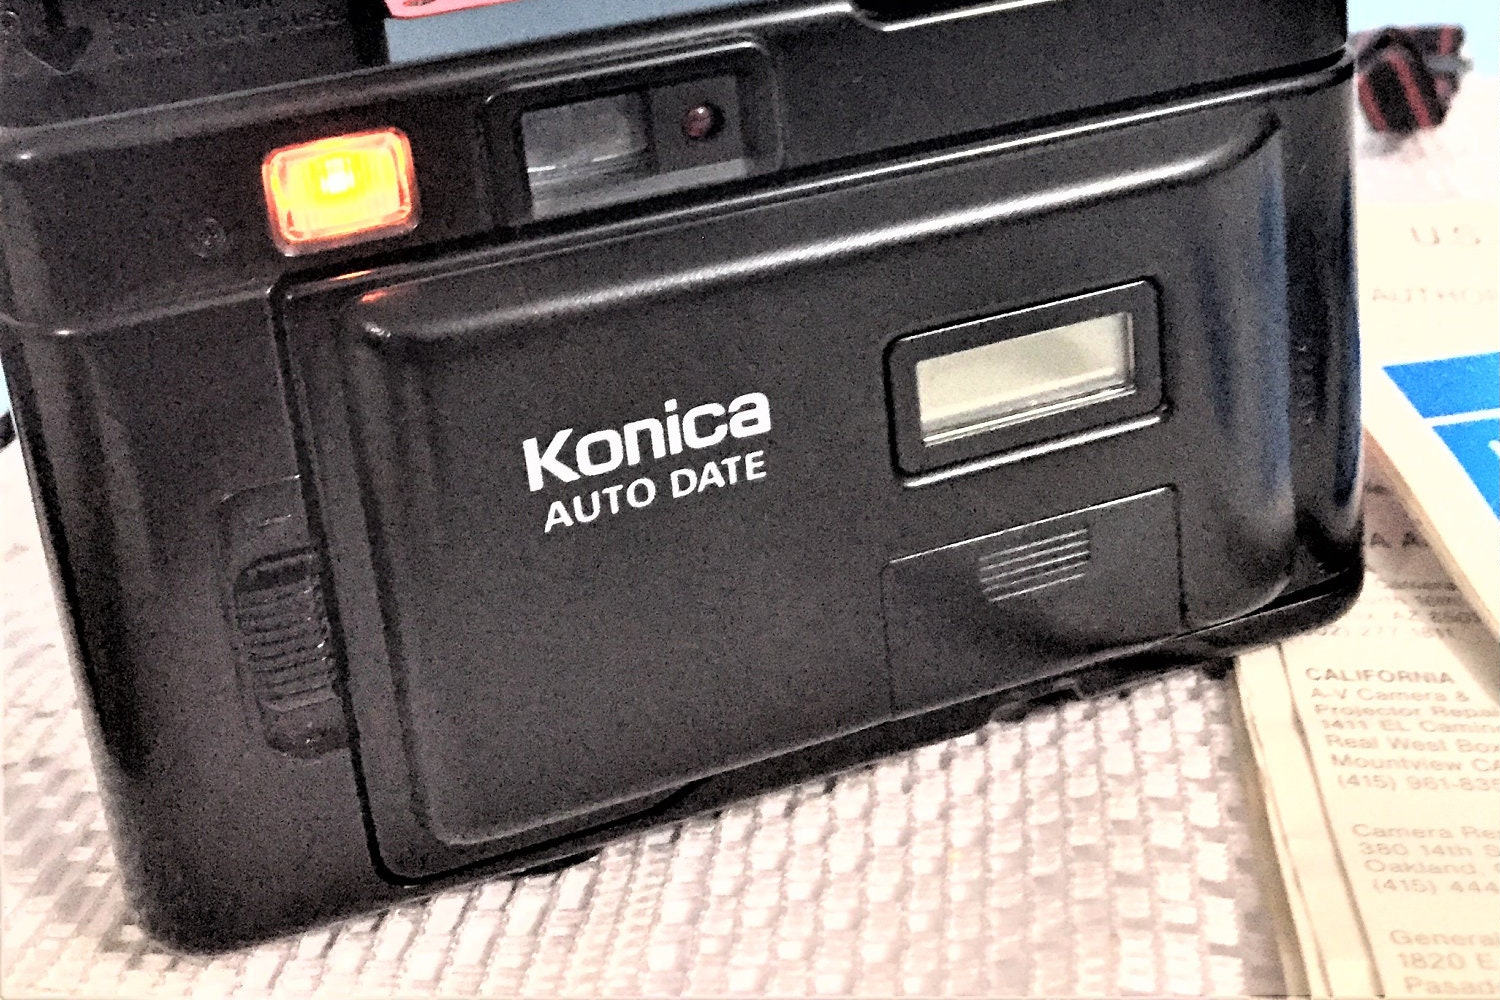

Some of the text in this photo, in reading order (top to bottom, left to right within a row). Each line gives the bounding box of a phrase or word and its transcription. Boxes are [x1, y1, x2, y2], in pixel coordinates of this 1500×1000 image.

[522, 392, 772, 492] Konica
[543, 450, 768, 534] AUTO DATE
[1305, 667, 1455, 684] CALIFORNIA
[1356, 687, 1449, 701] Camera
[1313, 703, 1421, 718] Projector
[1325, 733, 1380, 750] Real
[1385, 736, 1448, 752] West
[1330, 753, 1462, 771] Mountview
[1337, 774, 1397, 792] (415)
[1352, 823, 1453, 839] Camera
[1372, 878, 1438, 895] (415)
[1397, 951, 1467, 970] 1820
